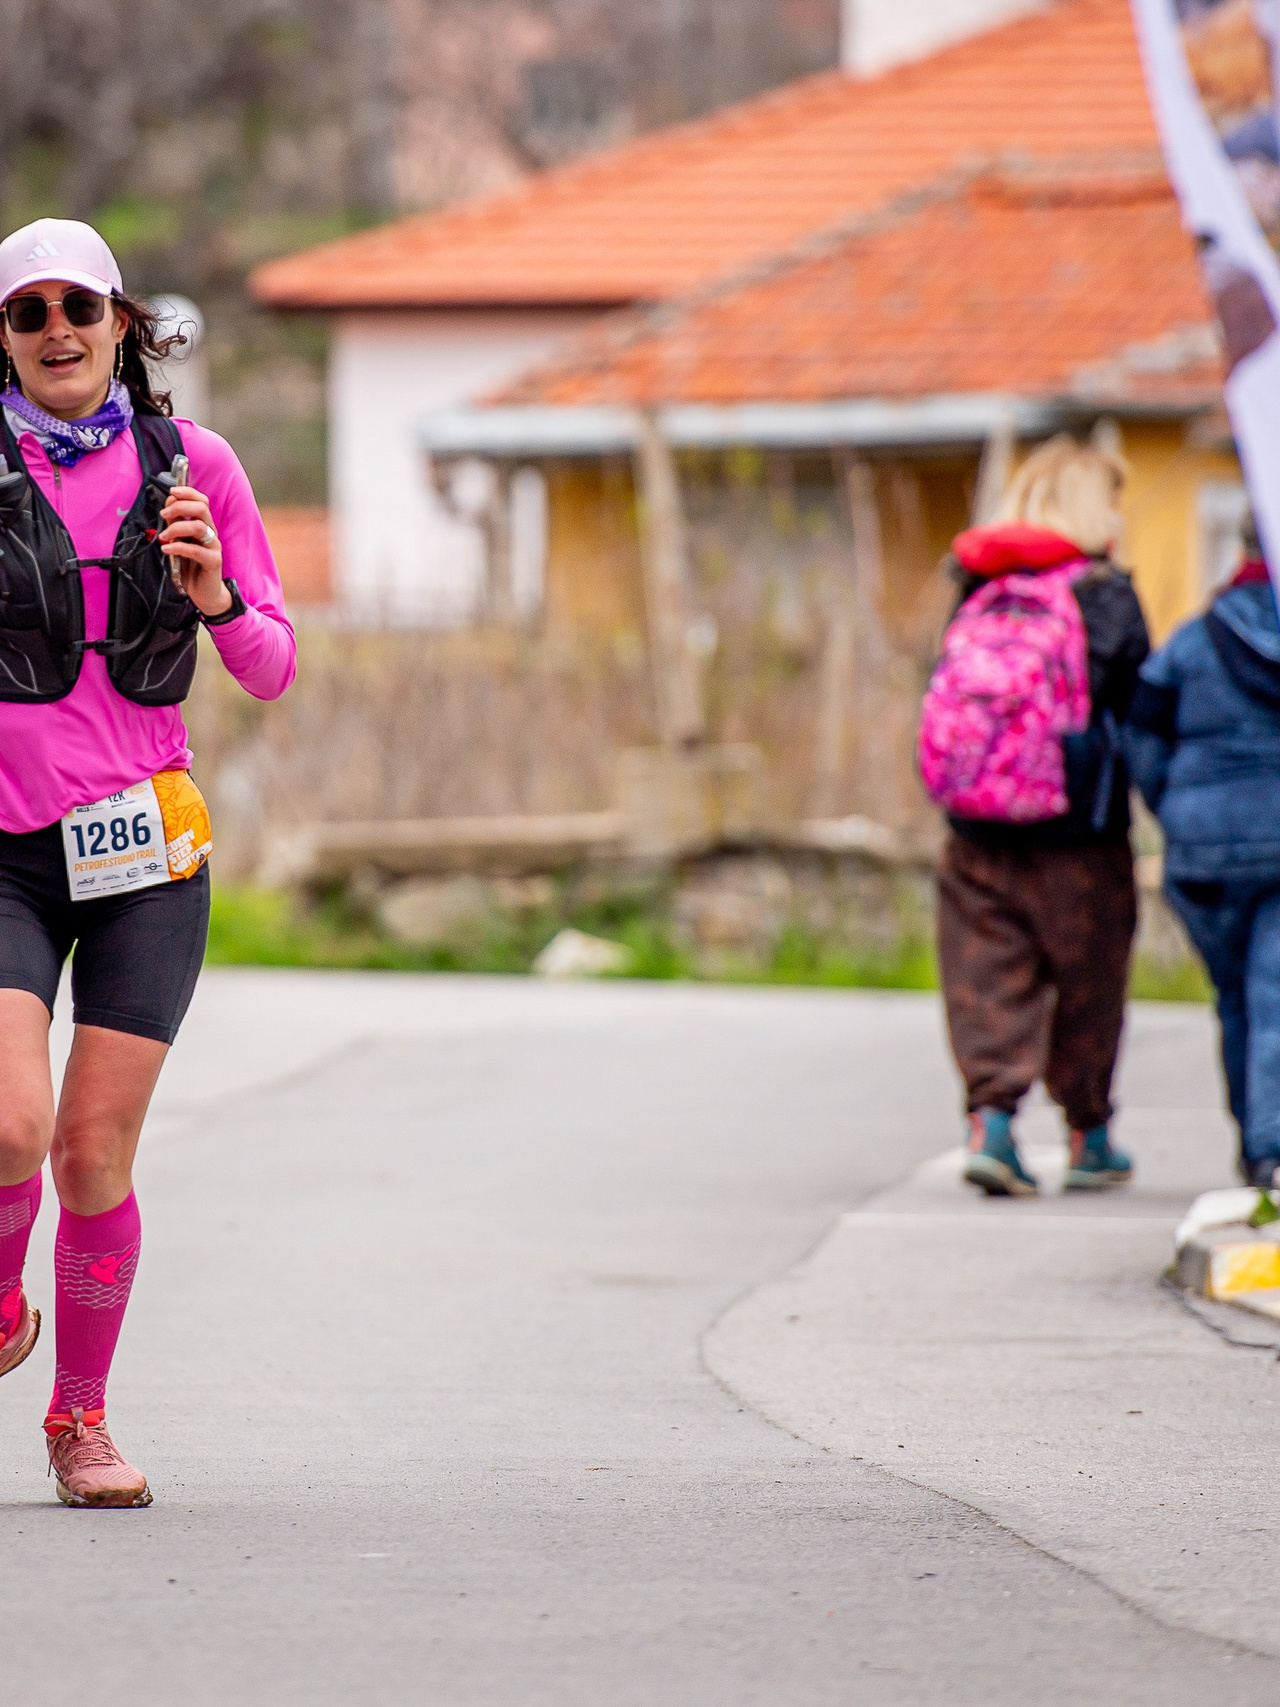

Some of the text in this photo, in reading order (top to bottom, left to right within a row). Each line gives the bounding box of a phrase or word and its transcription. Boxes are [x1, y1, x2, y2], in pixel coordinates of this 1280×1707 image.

[108, 790, 125, 803] 12K
[70, 812, 151, 858] 1286
[136, 848, 157, 860] TRAIL
[167, 842, 193, 864] STEP
